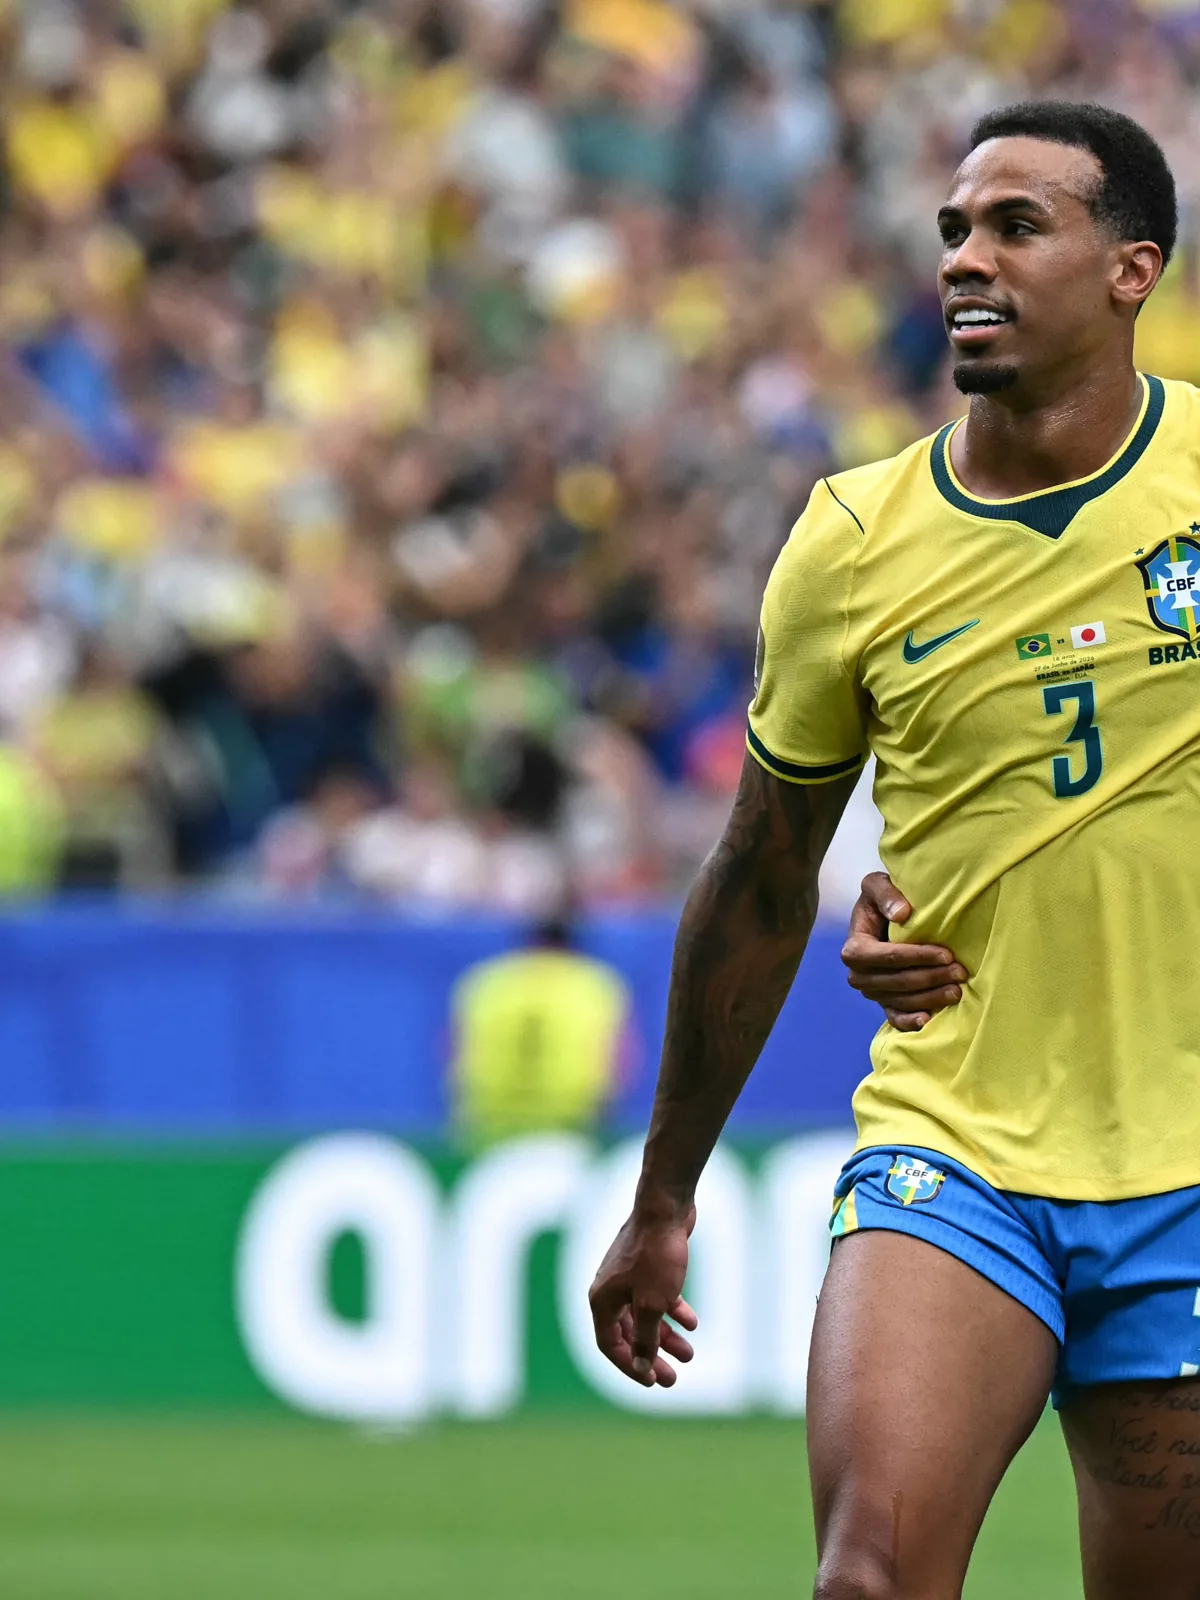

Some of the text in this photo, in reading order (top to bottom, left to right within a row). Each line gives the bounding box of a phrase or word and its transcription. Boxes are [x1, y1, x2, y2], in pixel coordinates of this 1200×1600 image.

[1166, 577, 1196, 593] CBF
[1072, 663, 1095, 673] JAPÃO
[1046, 676, 1070, 684] Houston
[1041, 680, 1103, 798] 3
[904, 1168, 928, 1178] CBF
